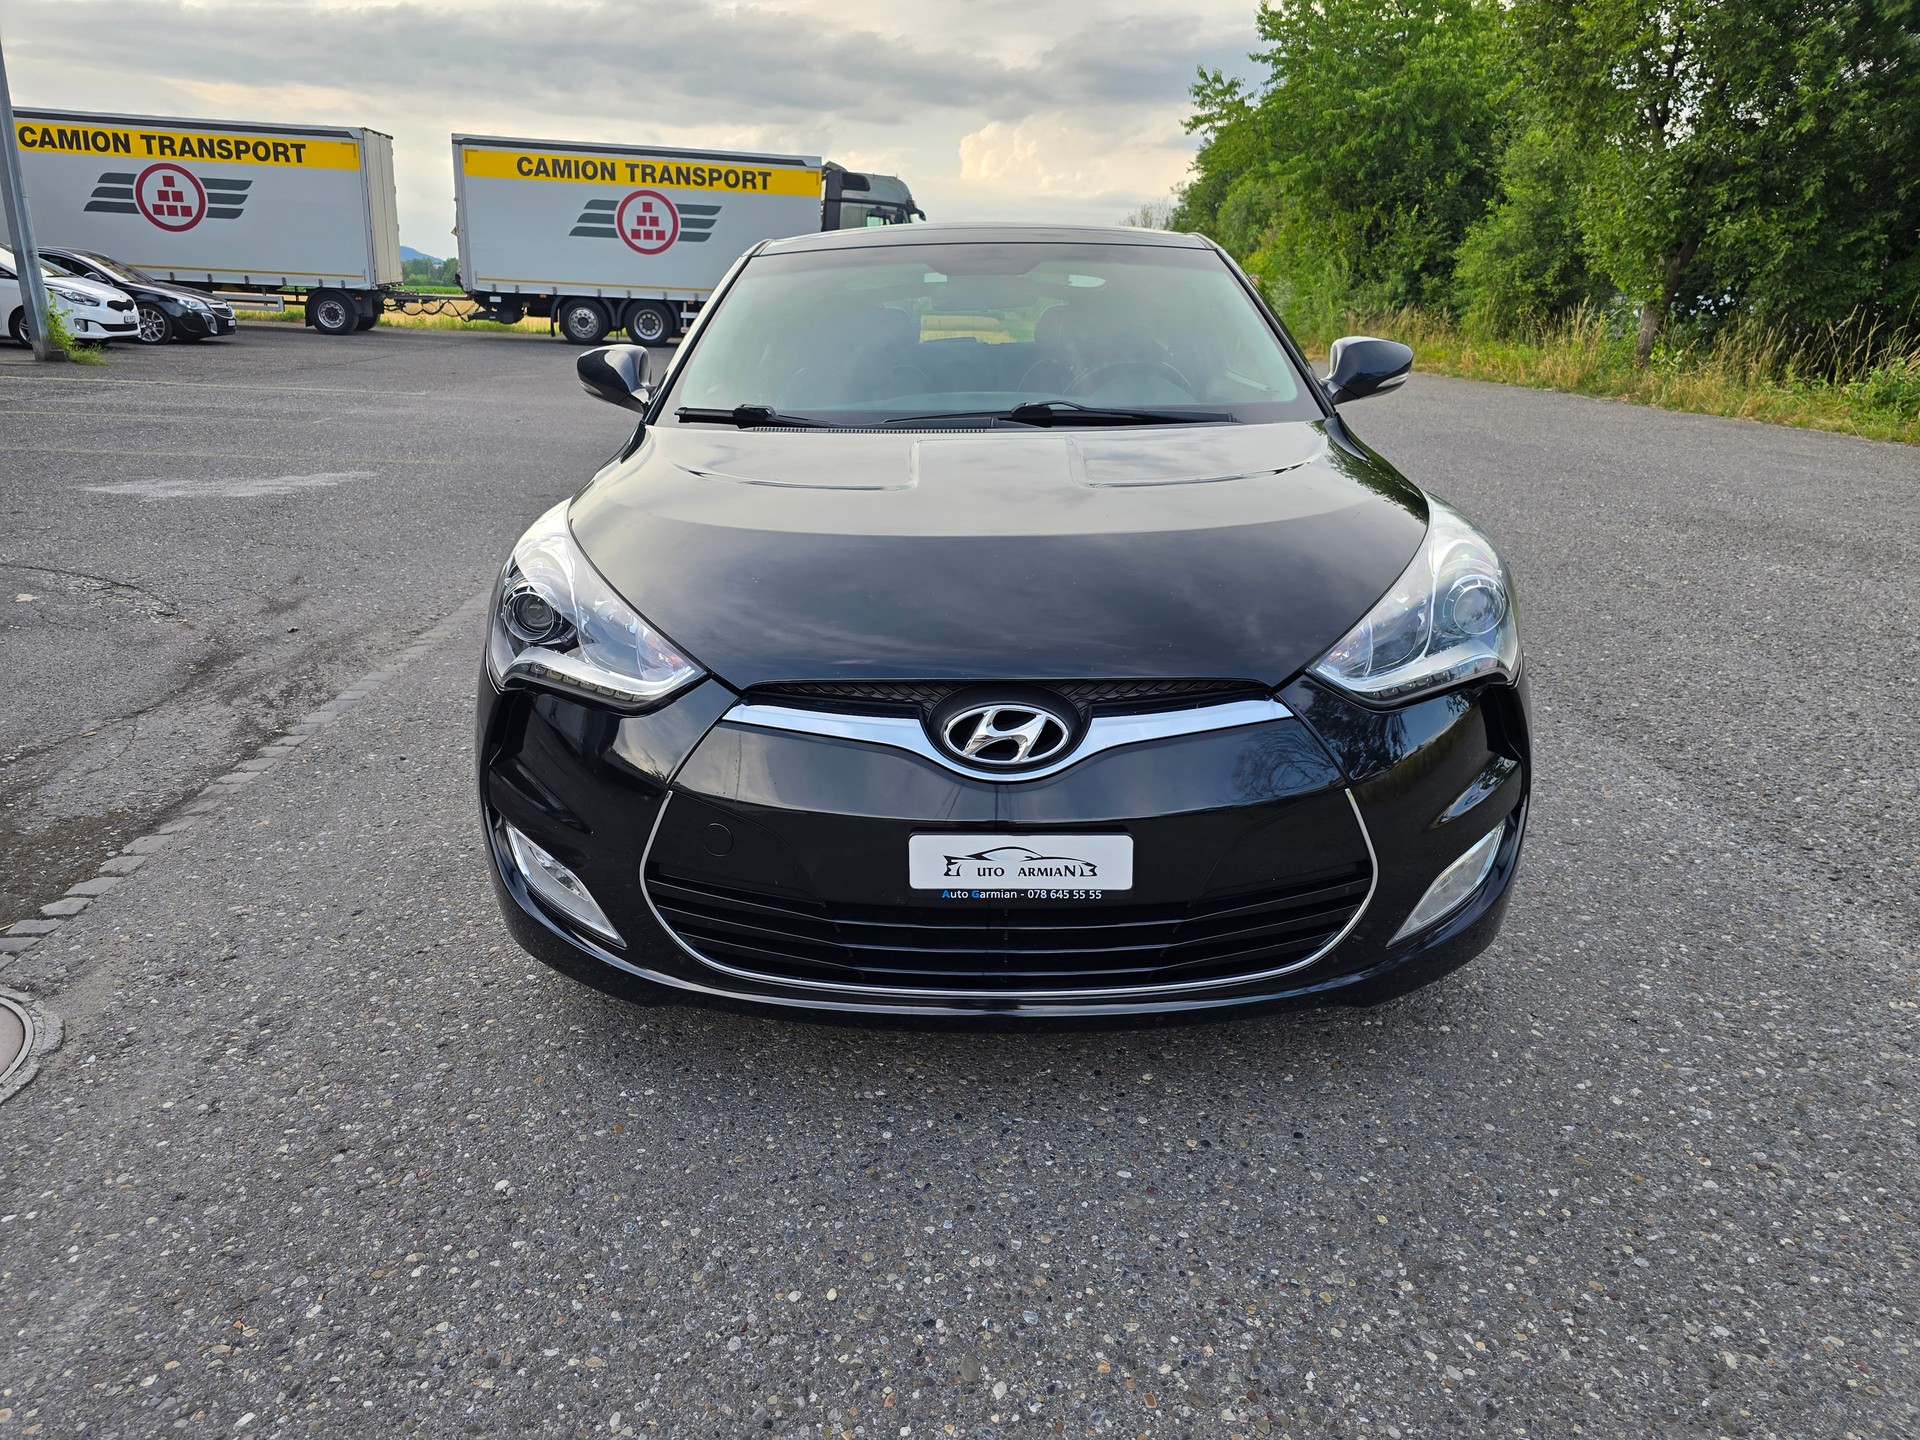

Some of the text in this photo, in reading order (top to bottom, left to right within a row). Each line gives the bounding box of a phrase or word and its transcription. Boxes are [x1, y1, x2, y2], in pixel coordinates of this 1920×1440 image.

[18, 126, 307, 164] CAMION TRANSPORT
[516, 155, 772, 190] CAMION TRANSPORT
[942, 889, 968, 899] Auto
[971, 889, 1017, 899] Garmian
[1028, 890, 1048, 899] 078
[1050, 889, 1070, 899] 645
[1072, 889, 1086, 899] 55
[1089, 889, 1102, 899] 55
